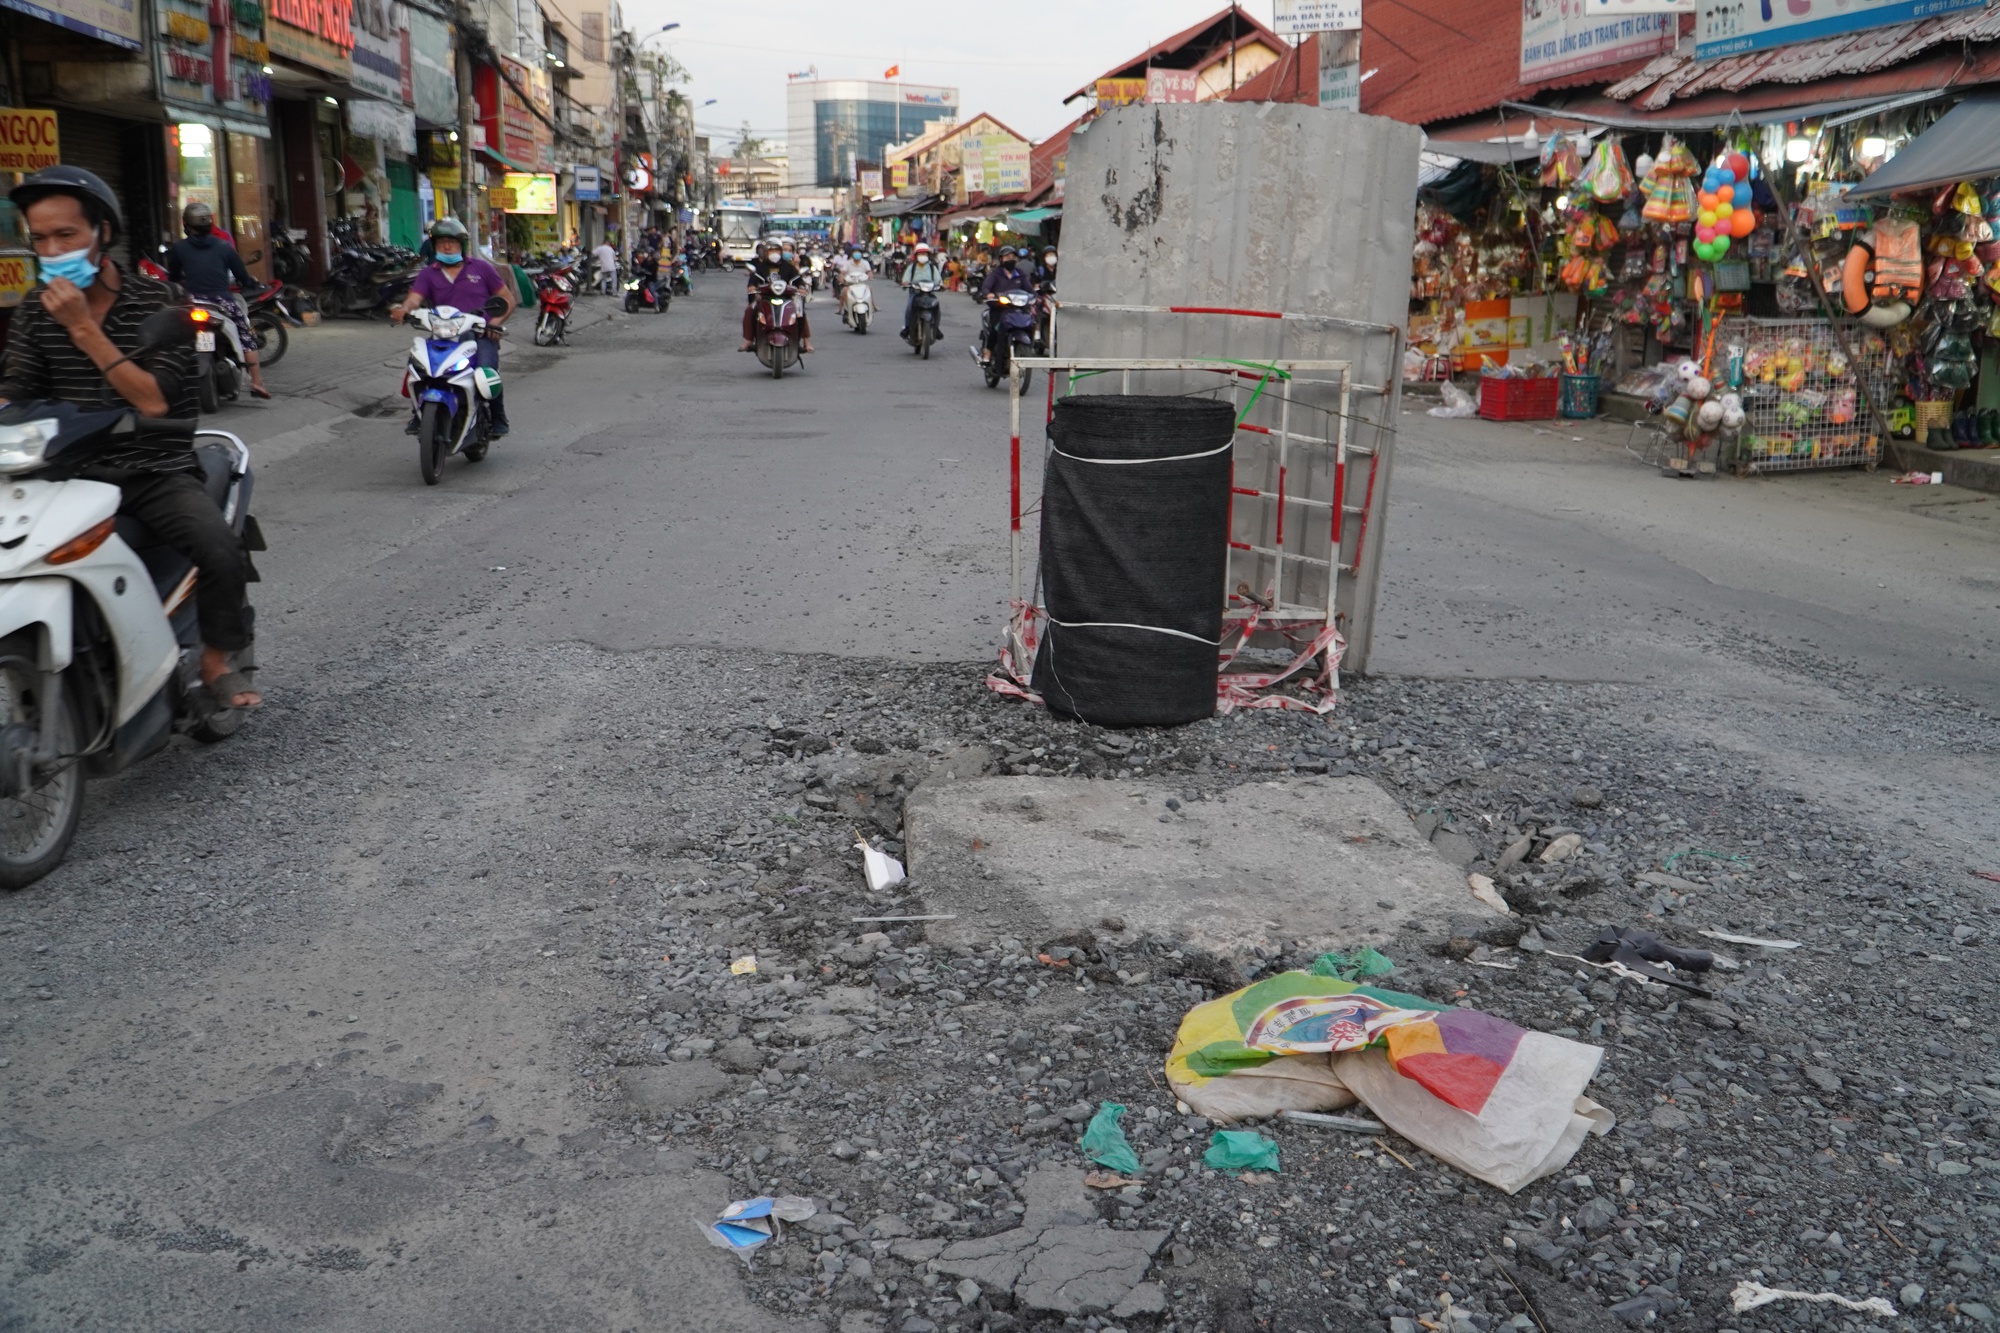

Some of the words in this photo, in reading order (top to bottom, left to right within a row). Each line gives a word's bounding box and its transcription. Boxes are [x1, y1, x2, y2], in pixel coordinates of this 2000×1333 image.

[1298, 3, 1338, 11] CHUYÊN
[1276, 14, 1298, 23] MUA
[1292, 22, 1320, 31] BÁNH
[1524, 42, 1541, 64] BÁNH
[1578, 25, 1593, 49] ĐÈN
[1595, 21, 1619, 45] TRANG
[1748, 37, 1754, 48] A
[0, 115, 57, 153] NGỌC
